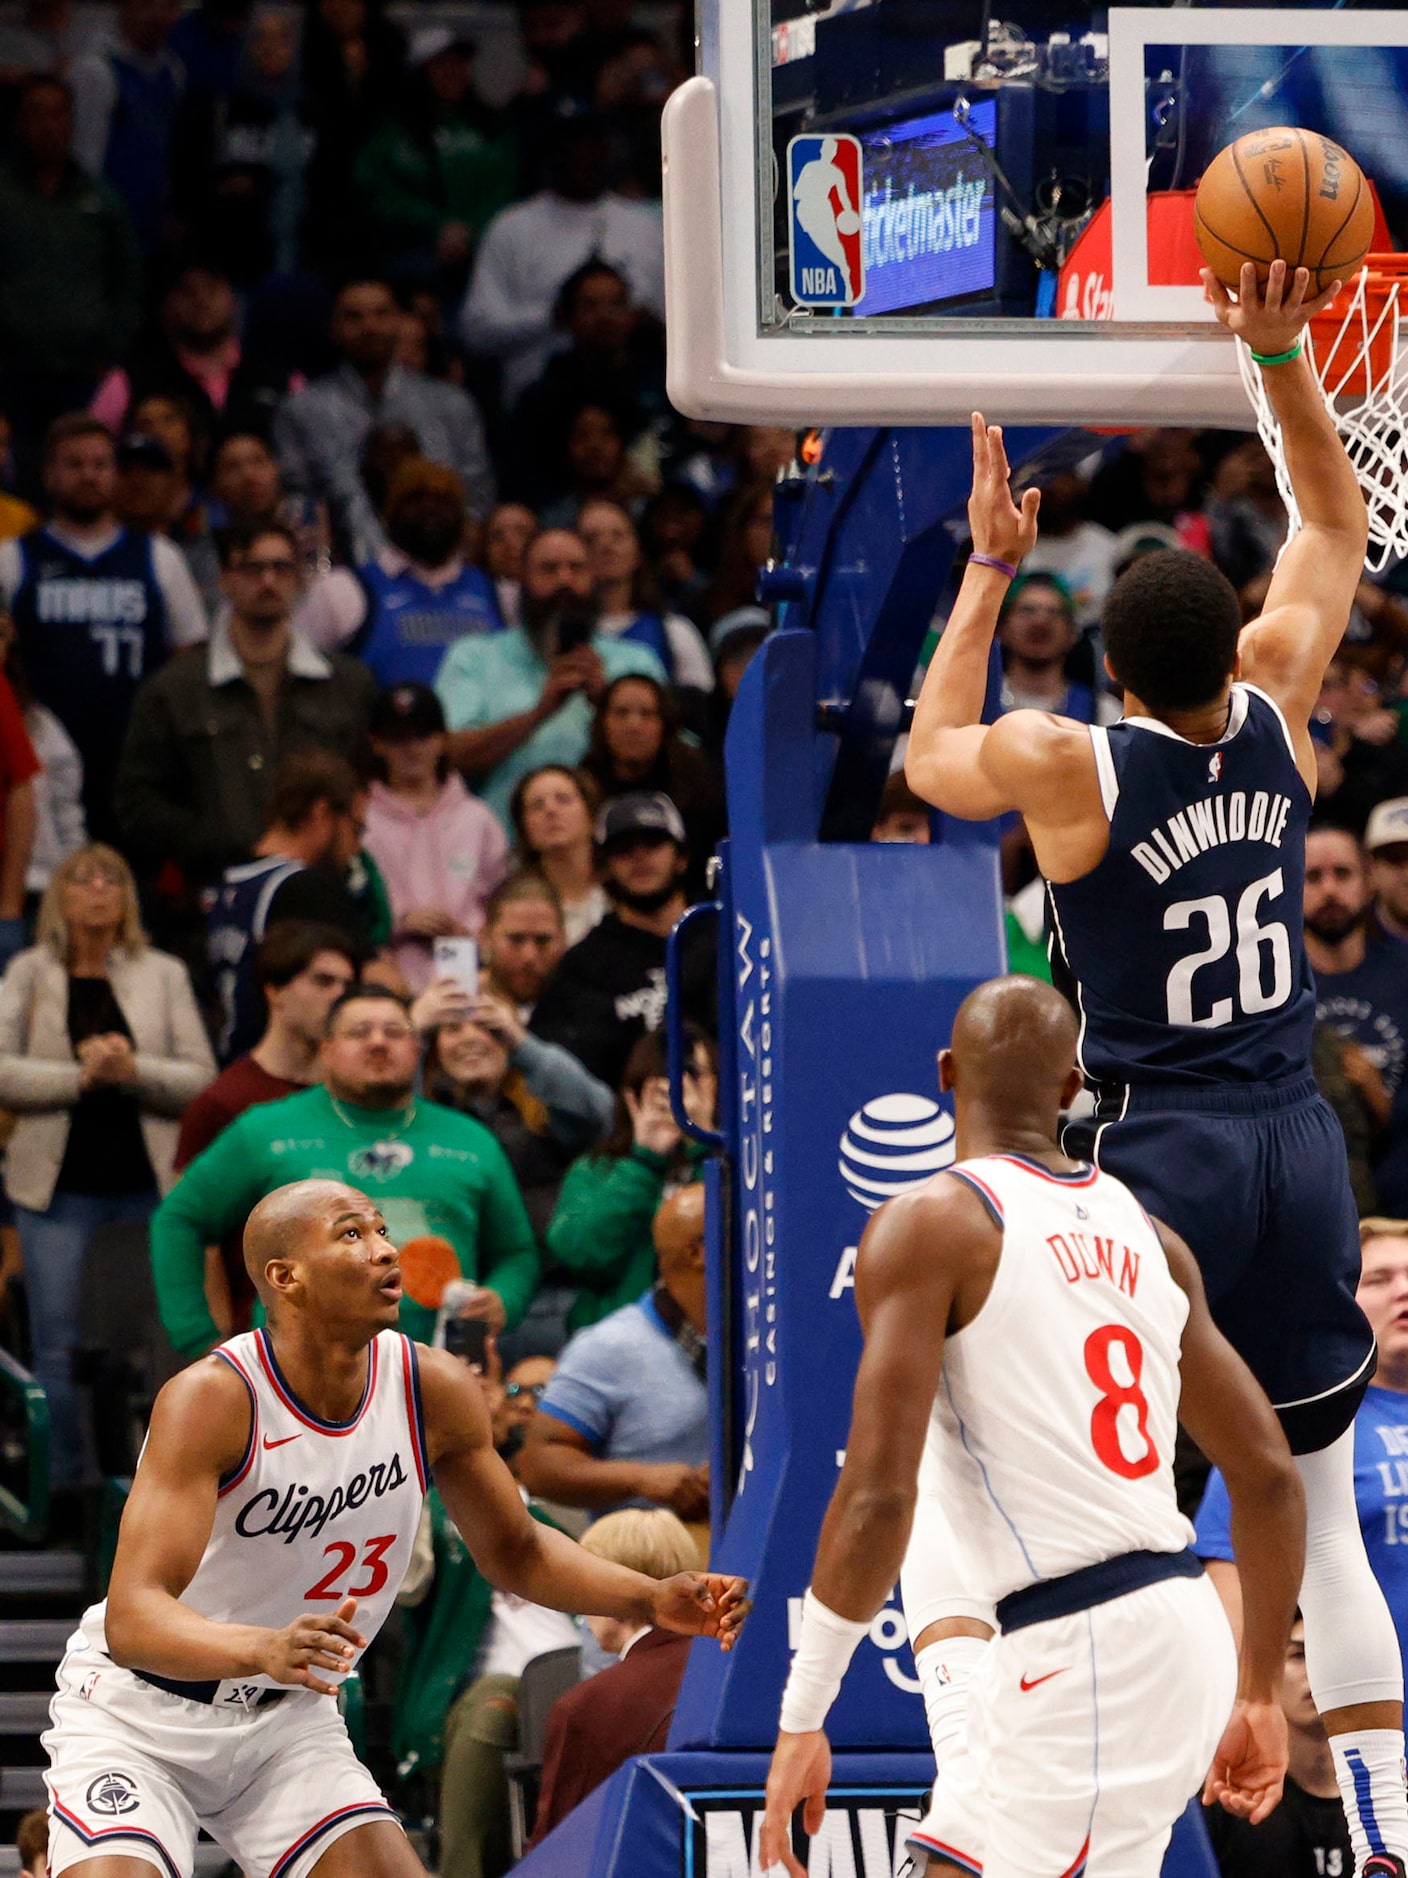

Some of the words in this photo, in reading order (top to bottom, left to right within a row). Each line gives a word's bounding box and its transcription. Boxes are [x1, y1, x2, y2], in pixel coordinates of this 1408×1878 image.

[801, 266, 838, 296] NBA
[91, 626, 143, 677] 77
[1130, 791, 1292, 885] DINWIDDIE
[1163, 867, 1293, 1029] 26
[760, 937, 774, 1133] RESORTS
[1046, 1232, 1141, 1299] DUNN
[1084, 1324, 1161, 1480] 8
[235, 1452, 408, 1545] Clippers
[303, 1534, 397, 1600] 23
